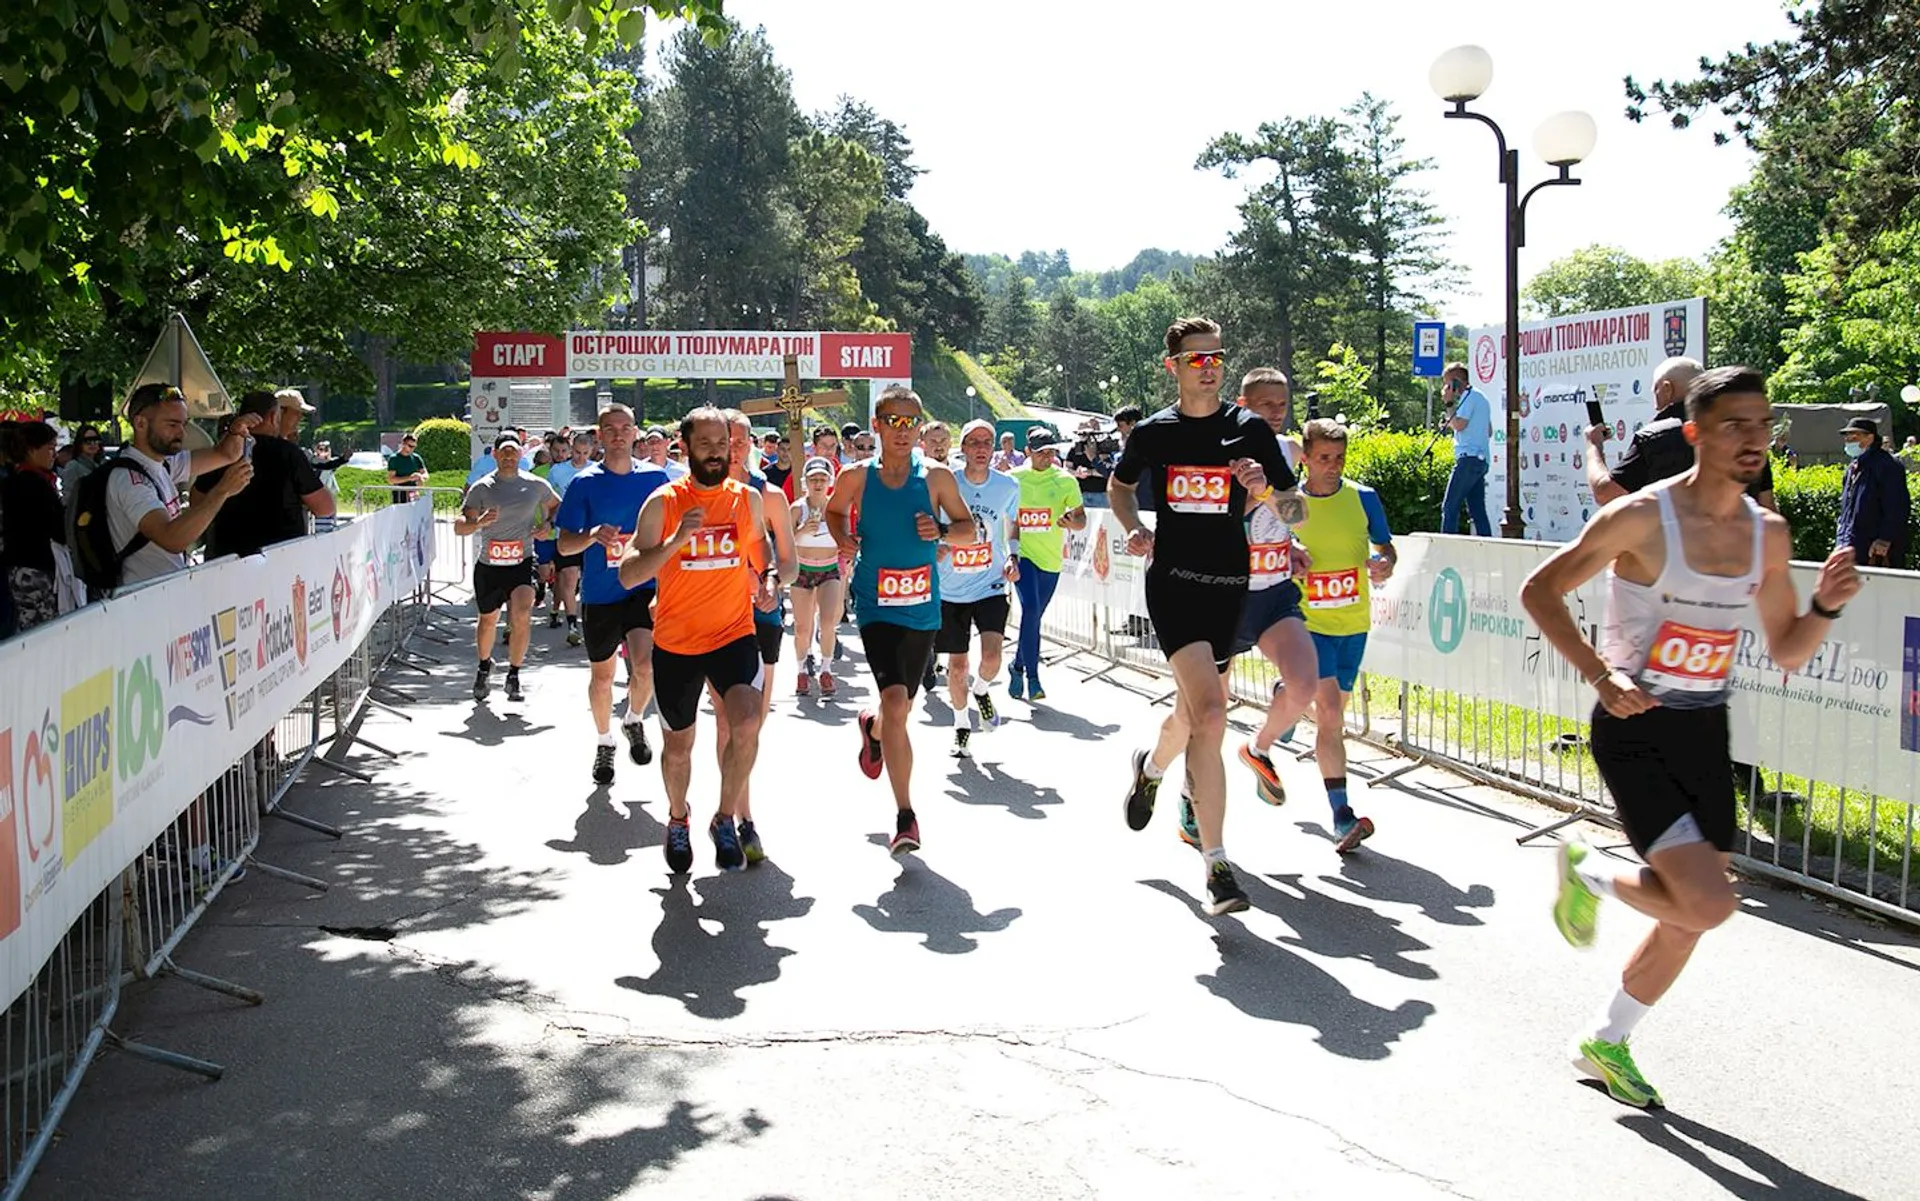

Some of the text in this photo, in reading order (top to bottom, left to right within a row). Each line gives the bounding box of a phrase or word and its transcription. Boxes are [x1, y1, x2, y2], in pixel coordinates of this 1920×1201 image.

[493, 344, 546, 366] СТАРТ
[573, 335, 670, 355] ОСТРОШКИ
[571, 358, 814, 373] OSTROG HALFMARATN
[840, 346, 893, 368] START
[1549, 348, 1648, 377] HALFMARATON
[1173, 475, 1225, 500] 033
[1021, 512, 1049, 525] 099
[492, 545, 520, 558] 056
[690, 532, 735, 557] 116
[956, 549, 989, 565] 073
[1250, 549, 1287, 571] 106
[883, 574, 927, 595] 086
[1313, 576, 1355, 597] 109
[1470, 612, 1524, 640] HIPOKRAT
[1660, 637, 1733, 673] 087
[1851, 666, 1888, 691] DOO
[76, 705, 110, 793] KIPS
